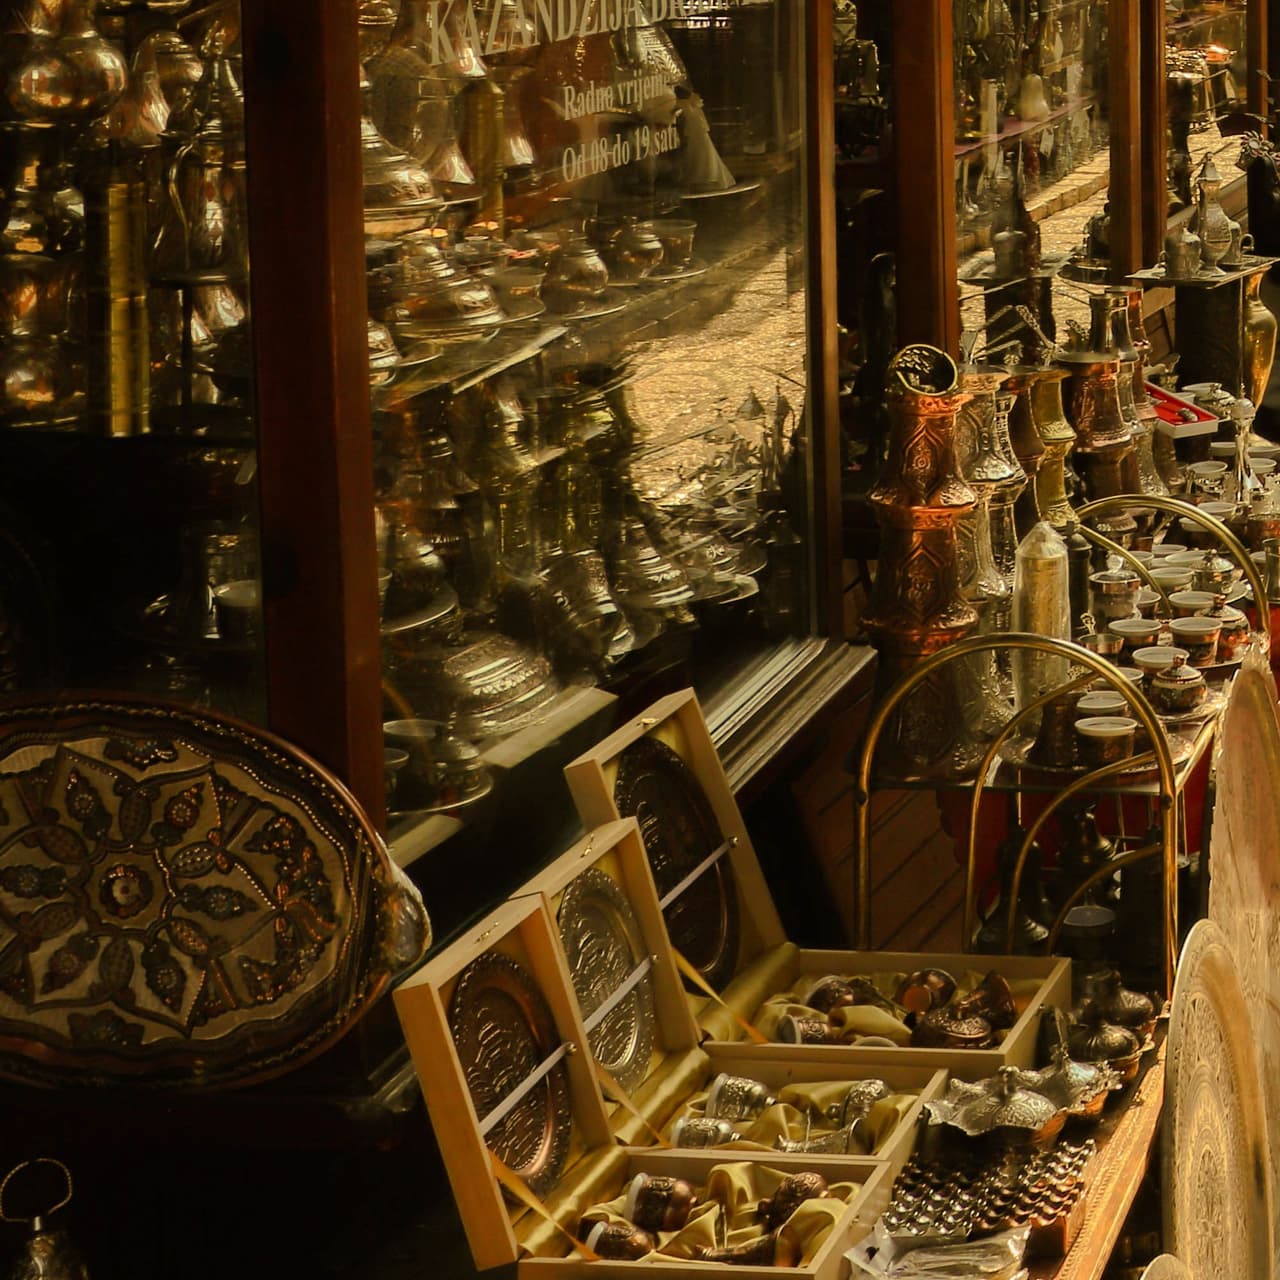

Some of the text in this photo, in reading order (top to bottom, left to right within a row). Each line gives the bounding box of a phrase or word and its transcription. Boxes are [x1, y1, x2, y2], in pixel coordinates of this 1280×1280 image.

[562, 81, 614, 121] Radno
[561, 124, 680, 183] Od 08 do 19 sati
